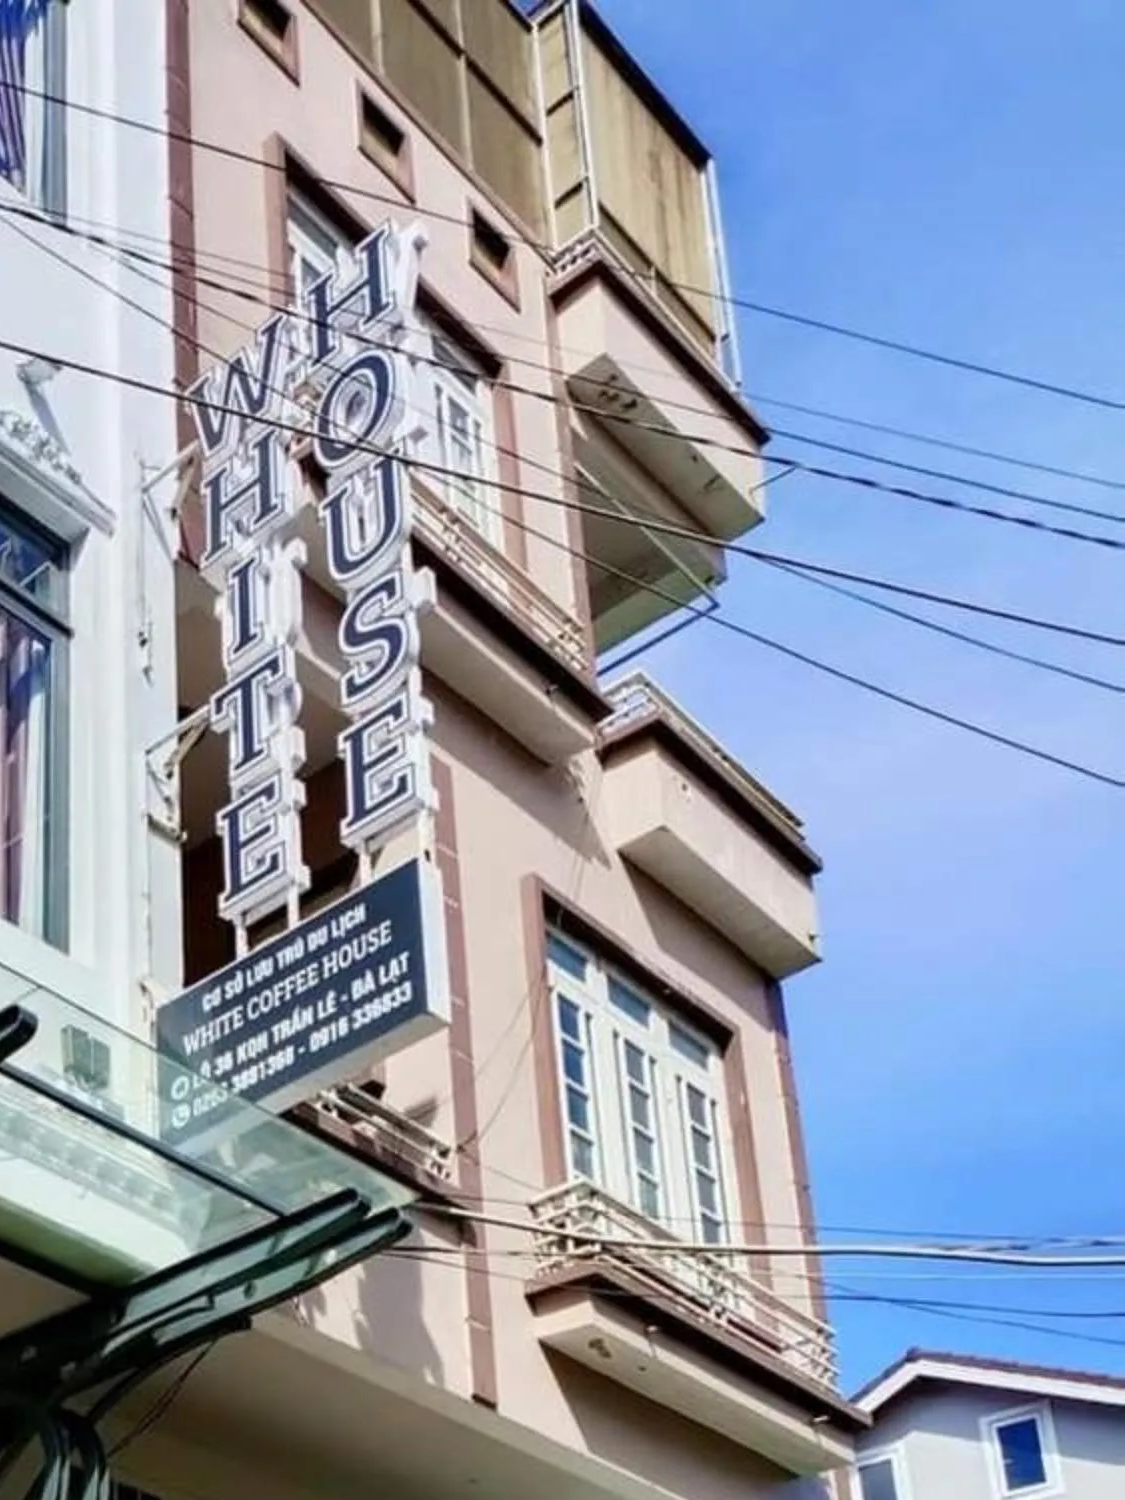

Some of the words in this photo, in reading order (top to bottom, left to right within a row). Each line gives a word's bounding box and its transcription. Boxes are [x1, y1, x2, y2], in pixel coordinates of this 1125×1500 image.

[309, 218, 417, 840] HOUSE
[184, 314, 291, 910] WHITE
[182, 1005, 244, 1057] WHITE
[246, 963, 319, 1020] COFFEE
[321, 919, 393, 980] HOUSE
[307, 924, 329, 953] DU
[330, 902, 367, 938] LỊCH
[378, 951, 411, 985] LẠT
